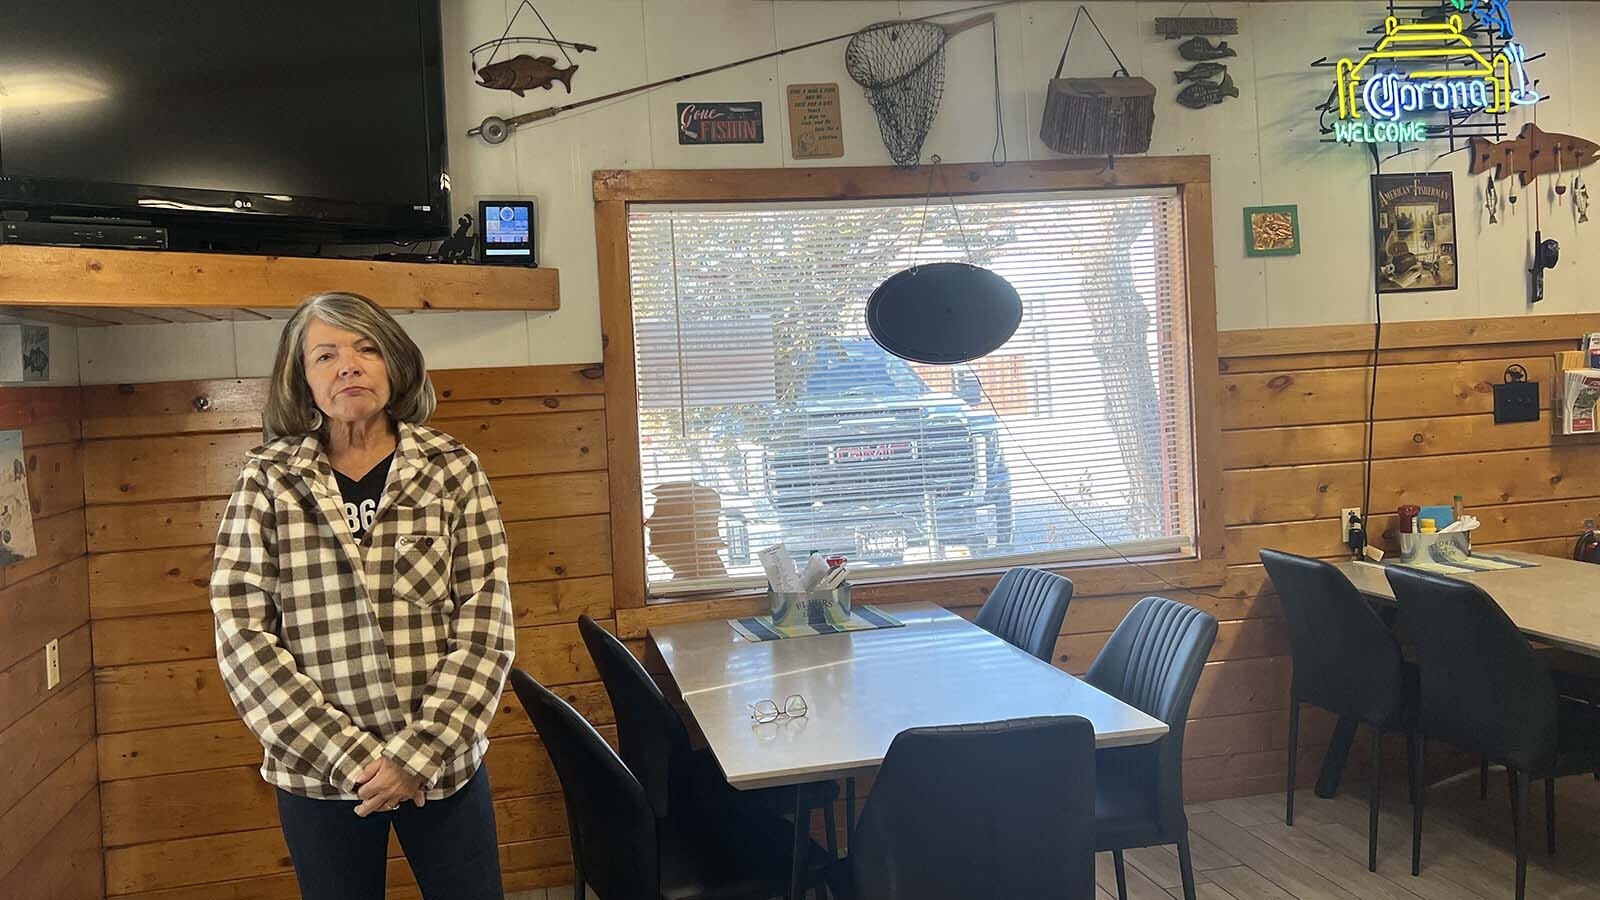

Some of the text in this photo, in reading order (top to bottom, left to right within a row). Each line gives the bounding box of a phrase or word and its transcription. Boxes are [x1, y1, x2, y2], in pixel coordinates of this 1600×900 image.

[1363, 73, 1489, 121] Corona
[681, 104, 725, 128] Gone
[1335, 120, 1427, 143] WELCOME
